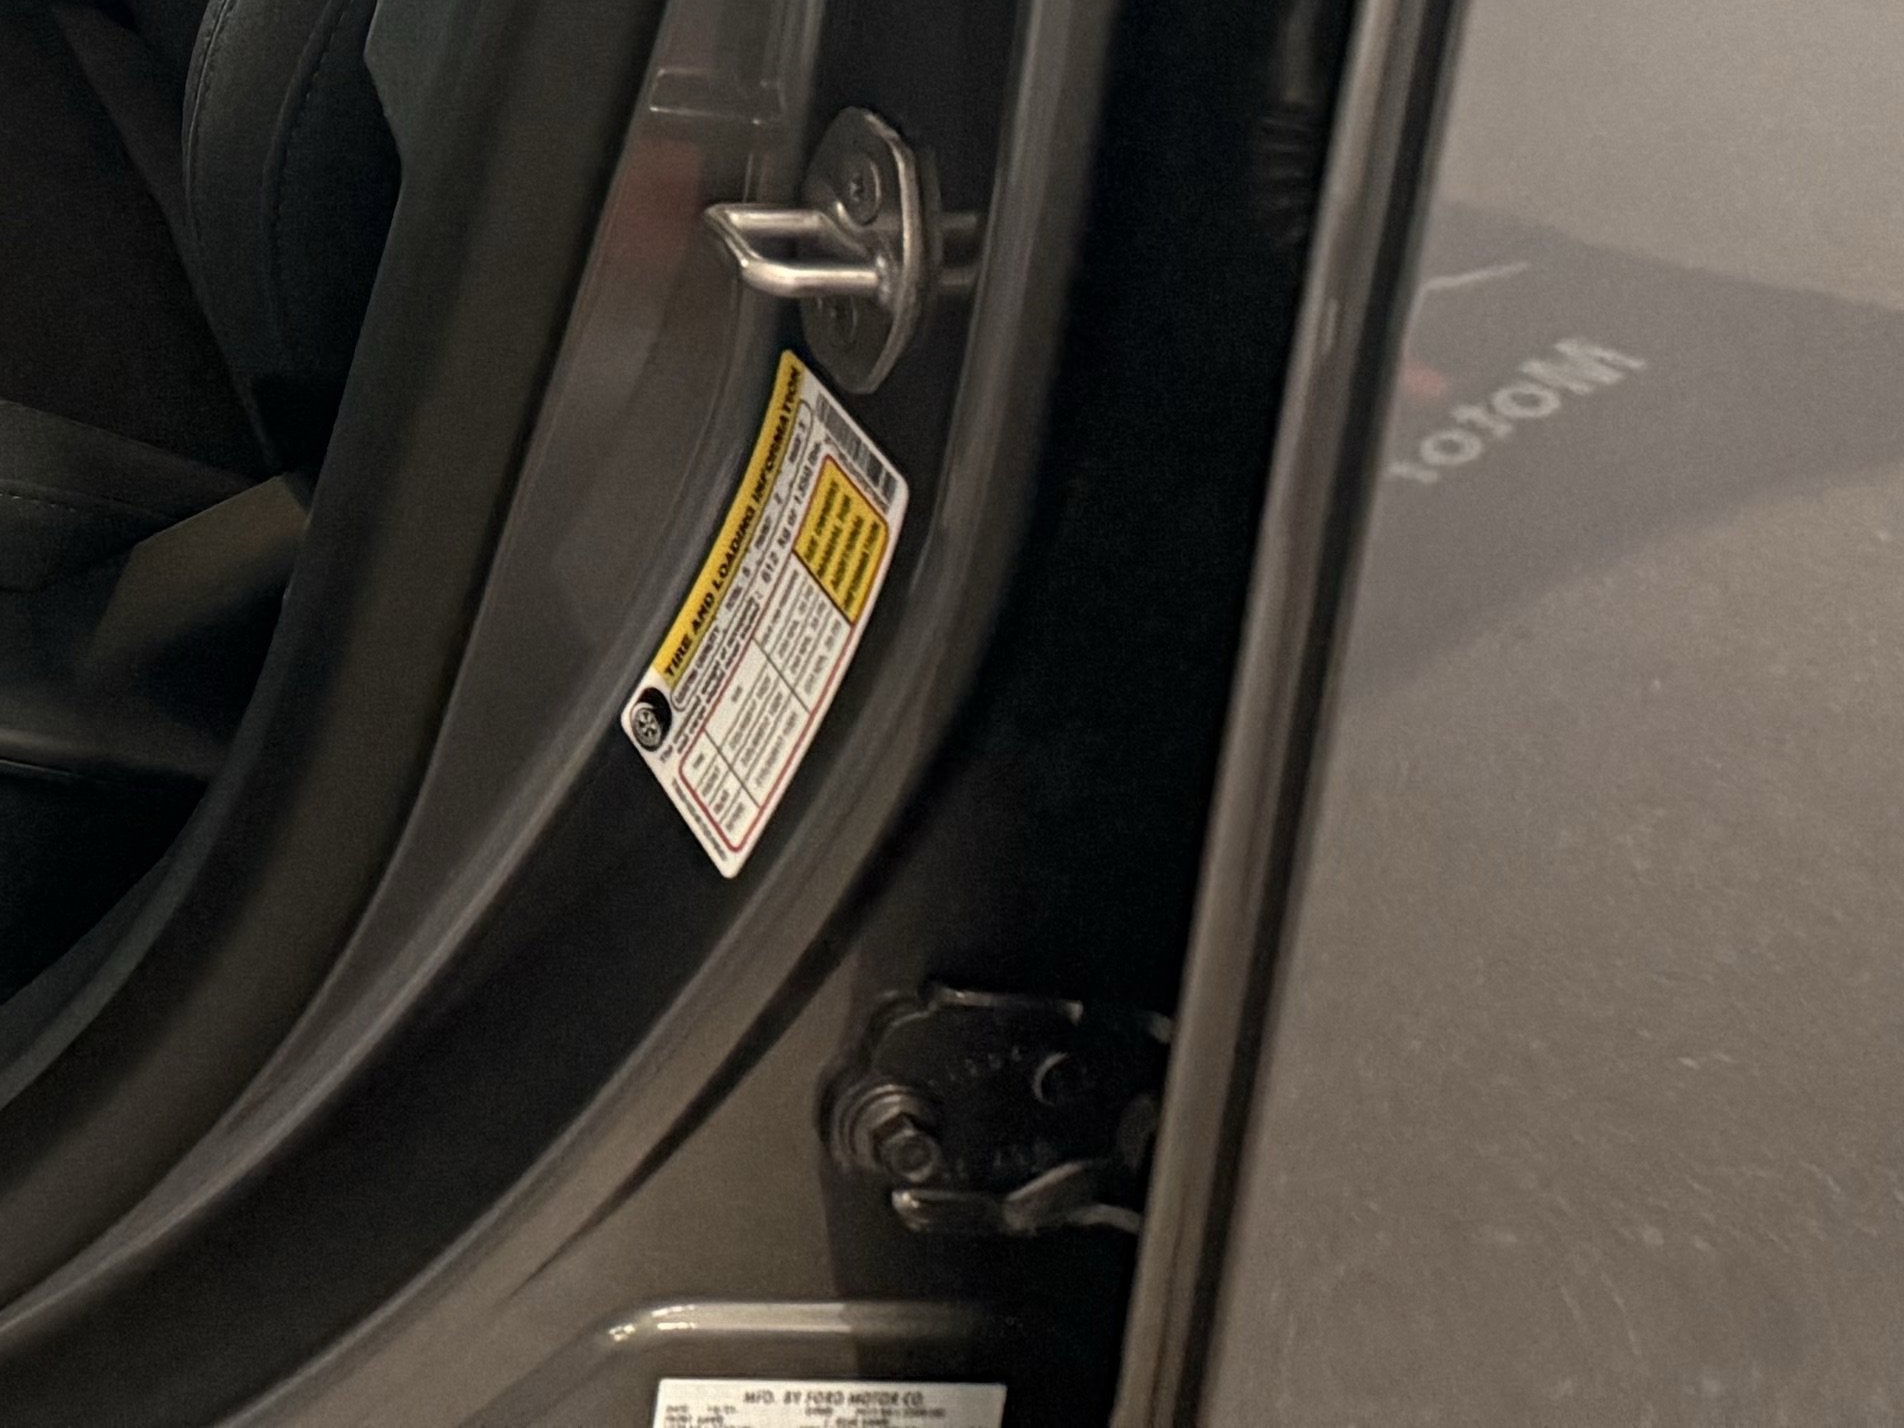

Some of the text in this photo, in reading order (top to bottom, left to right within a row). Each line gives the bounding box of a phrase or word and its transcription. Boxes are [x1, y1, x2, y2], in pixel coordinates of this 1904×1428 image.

[665, 368, 799, 676] TIRE AND LOADING INFORMATION
